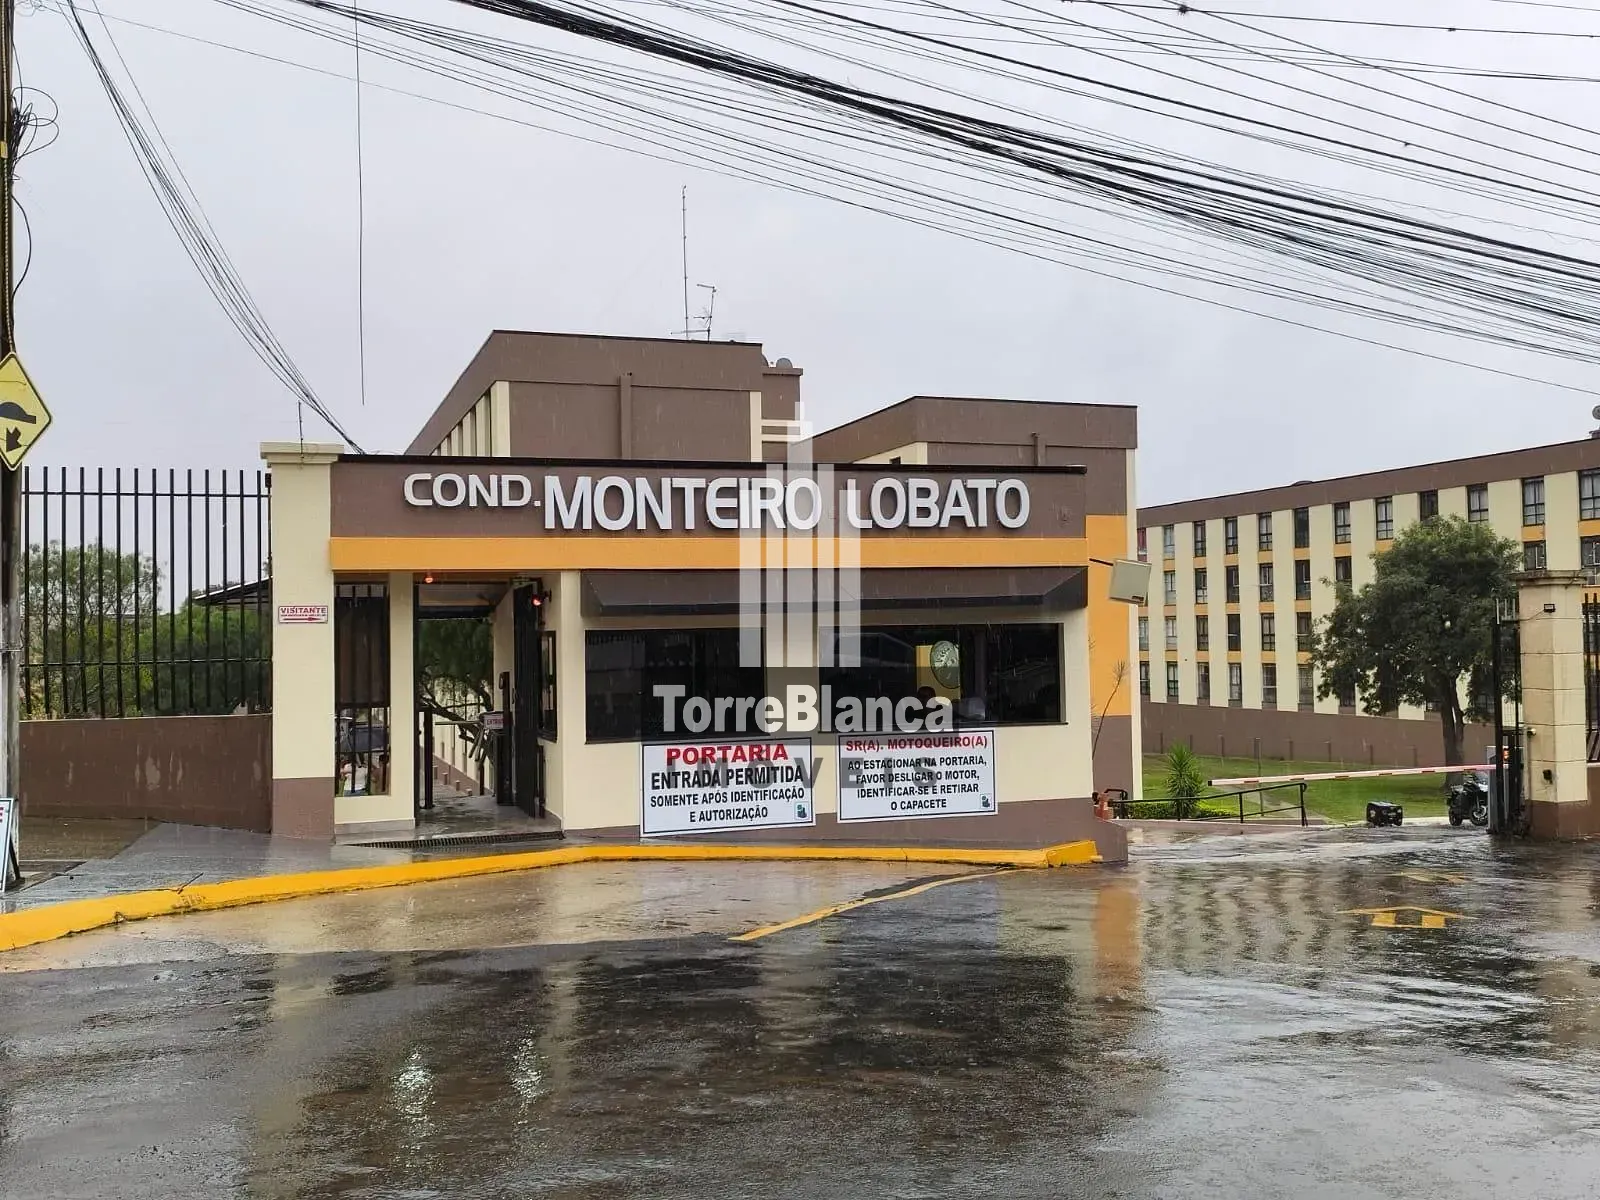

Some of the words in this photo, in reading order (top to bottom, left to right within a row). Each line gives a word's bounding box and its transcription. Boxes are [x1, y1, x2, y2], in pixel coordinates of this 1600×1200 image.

[404, 473, 541, 507] COND.
[544, 476, 823, 531] MONTEIRO
[847, 477, 1030, 529] LOBATO
[846, 739, 884, 753] SR(A).
[887, 735, 987, 750] MOTOQUEIRO(A)
[667, 743, 788, 766] PORTARIA
[848, 760, 861, 770] AO
[863, 757, 922, 770] ESTACIONAR
[924, 757, 937, 767] NA
[939, 755, 987, 767] PORTARIA,
[651, 769, 721, 790] ENTRADA
[726, 765, 804, 785] PERMITIDA
[856, 774, 886, 784] FAVOR
[888, 771, 933, 782] DESLIGAR
[935, 771, 942, 780] O
[650, 793, 699, 808] SOMENTE
[701, 790, 728, 804] APÓS
[730, 785, 805, 803] IDENTIFICAÇÃO
[857, 786, 929, 799] IDENTIFICAR-SE
[932, 784, 938, 794] E
[940, 783, 979, 794] RETIRAR
[689, 811, 696, 823] E
[699, 804, 769, 822] AUTORIZAÇÃO
[890, 801, 898, 811] O
[900, 799, 947, 810] CAPACETE
